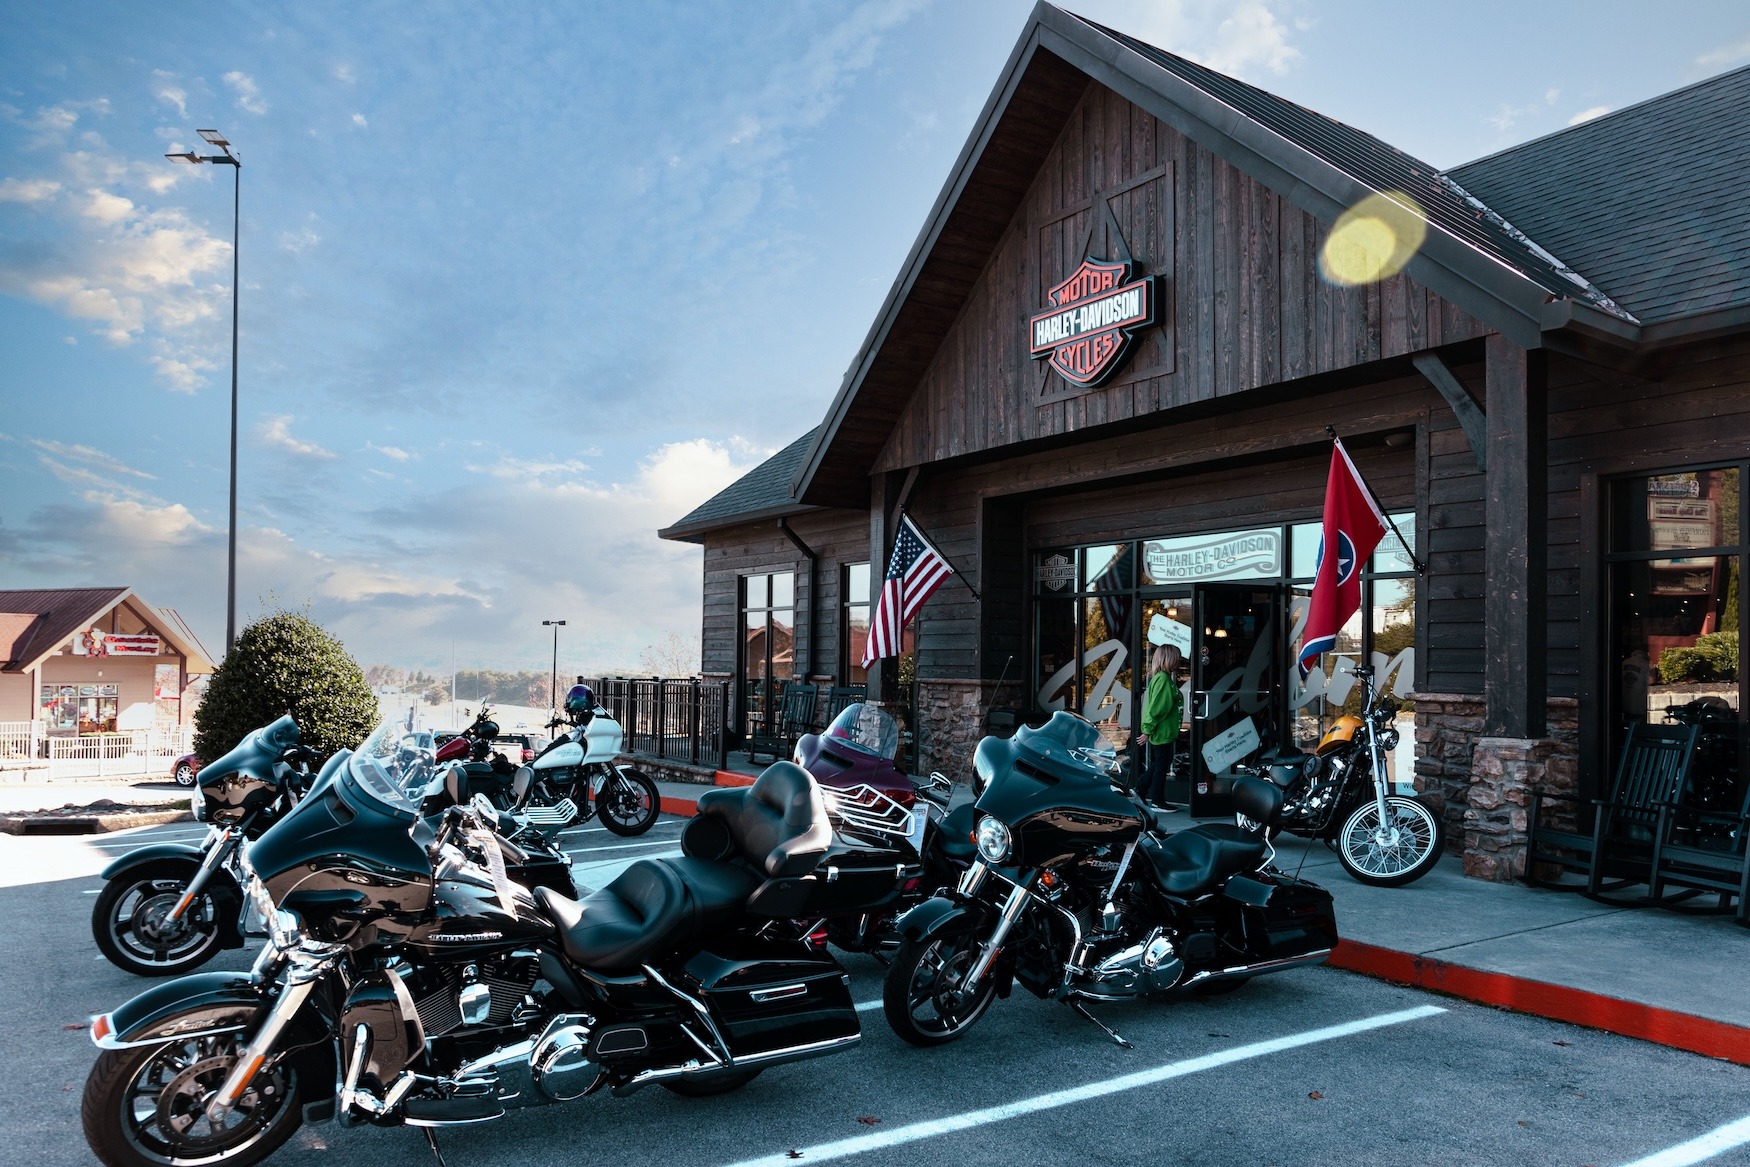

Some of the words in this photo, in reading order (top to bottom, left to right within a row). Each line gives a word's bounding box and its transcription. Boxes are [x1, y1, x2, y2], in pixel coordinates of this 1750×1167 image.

[1059, 270, 1114, 304] MOTOR
[1036, 289, 1140, 346] HARLEY-DAVIDSON
[1058, 333, 1114, 374] CYCLES
[1149, 554, 1164, 563] THE
[1166, 537, 1274, 567] HARLEY-DAVIDSON
[1166, 563, 1213, 577] MOTOR
